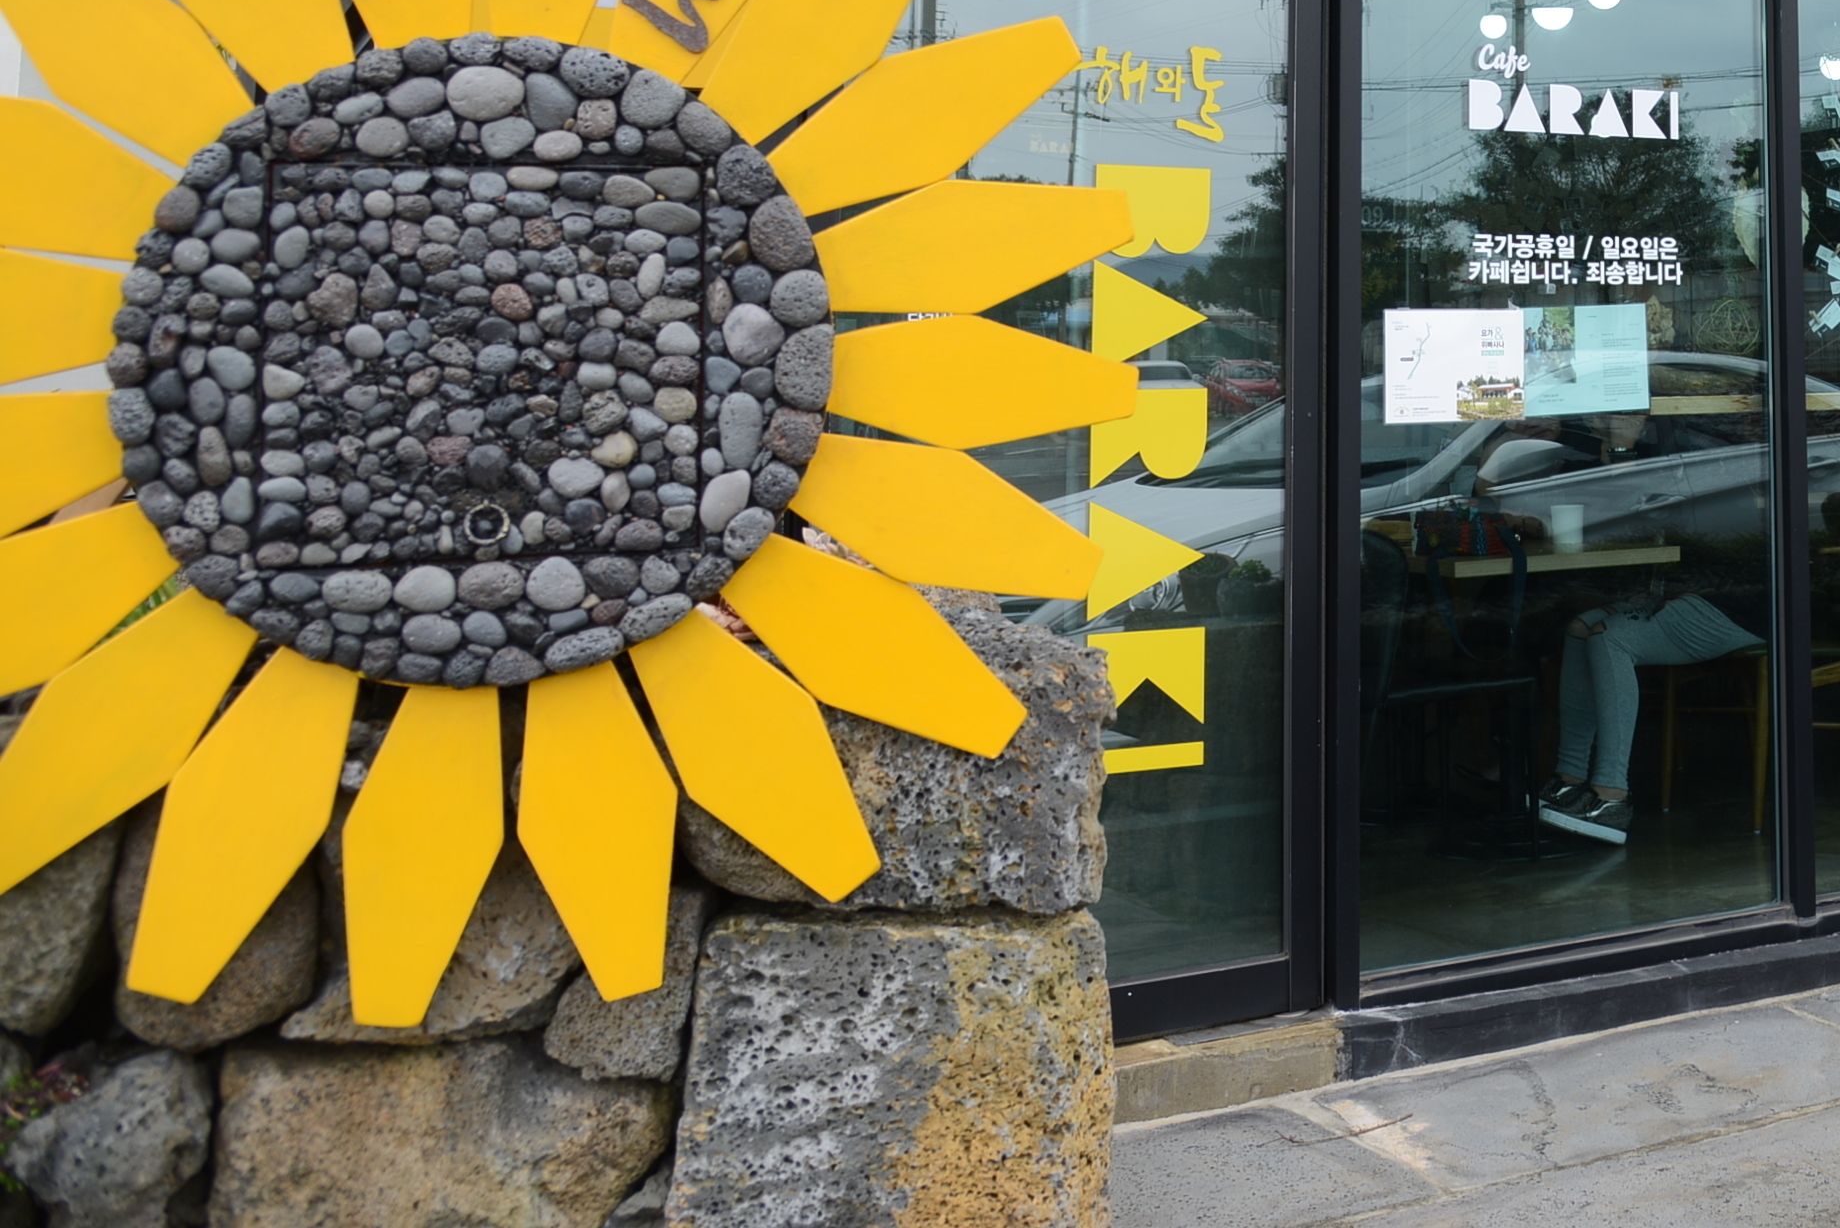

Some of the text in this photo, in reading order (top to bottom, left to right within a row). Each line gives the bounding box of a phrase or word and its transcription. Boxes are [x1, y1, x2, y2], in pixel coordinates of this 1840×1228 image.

[1477, 43, 1531, 78] Cafe
[1468, 78, 1680, 140] BARAKI
[1472, 234, 1575, 259] 국가공휴일
[1601, 236, 1679, 260] 일요일은
[1468, 260, 1683, 285] 카페쉽니다. 죄송합니다
